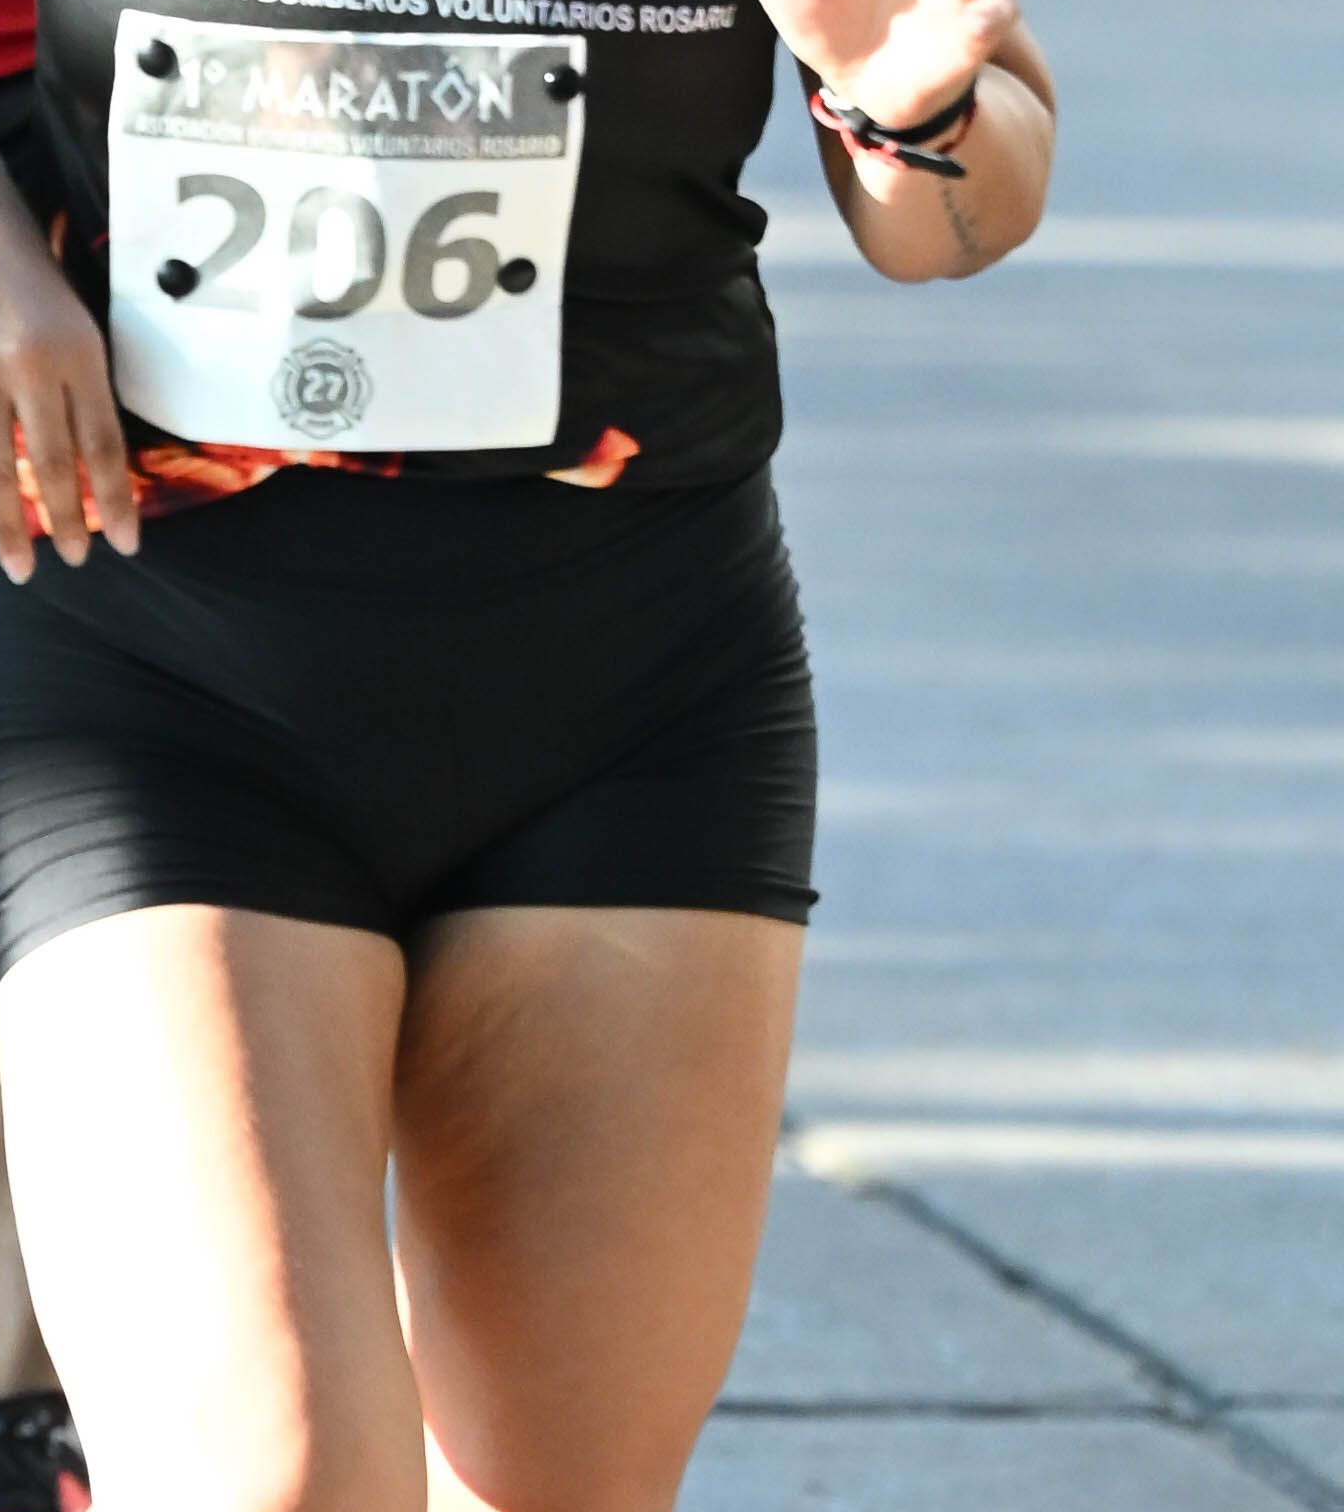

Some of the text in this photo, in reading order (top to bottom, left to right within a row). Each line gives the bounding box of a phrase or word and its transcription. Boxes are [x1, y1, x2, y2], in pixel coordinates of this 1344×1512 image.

[241, 54, 513, 124] MARATÓN
[176, 173, 502, 321] 206
[302, 367, 344, 404] 27
